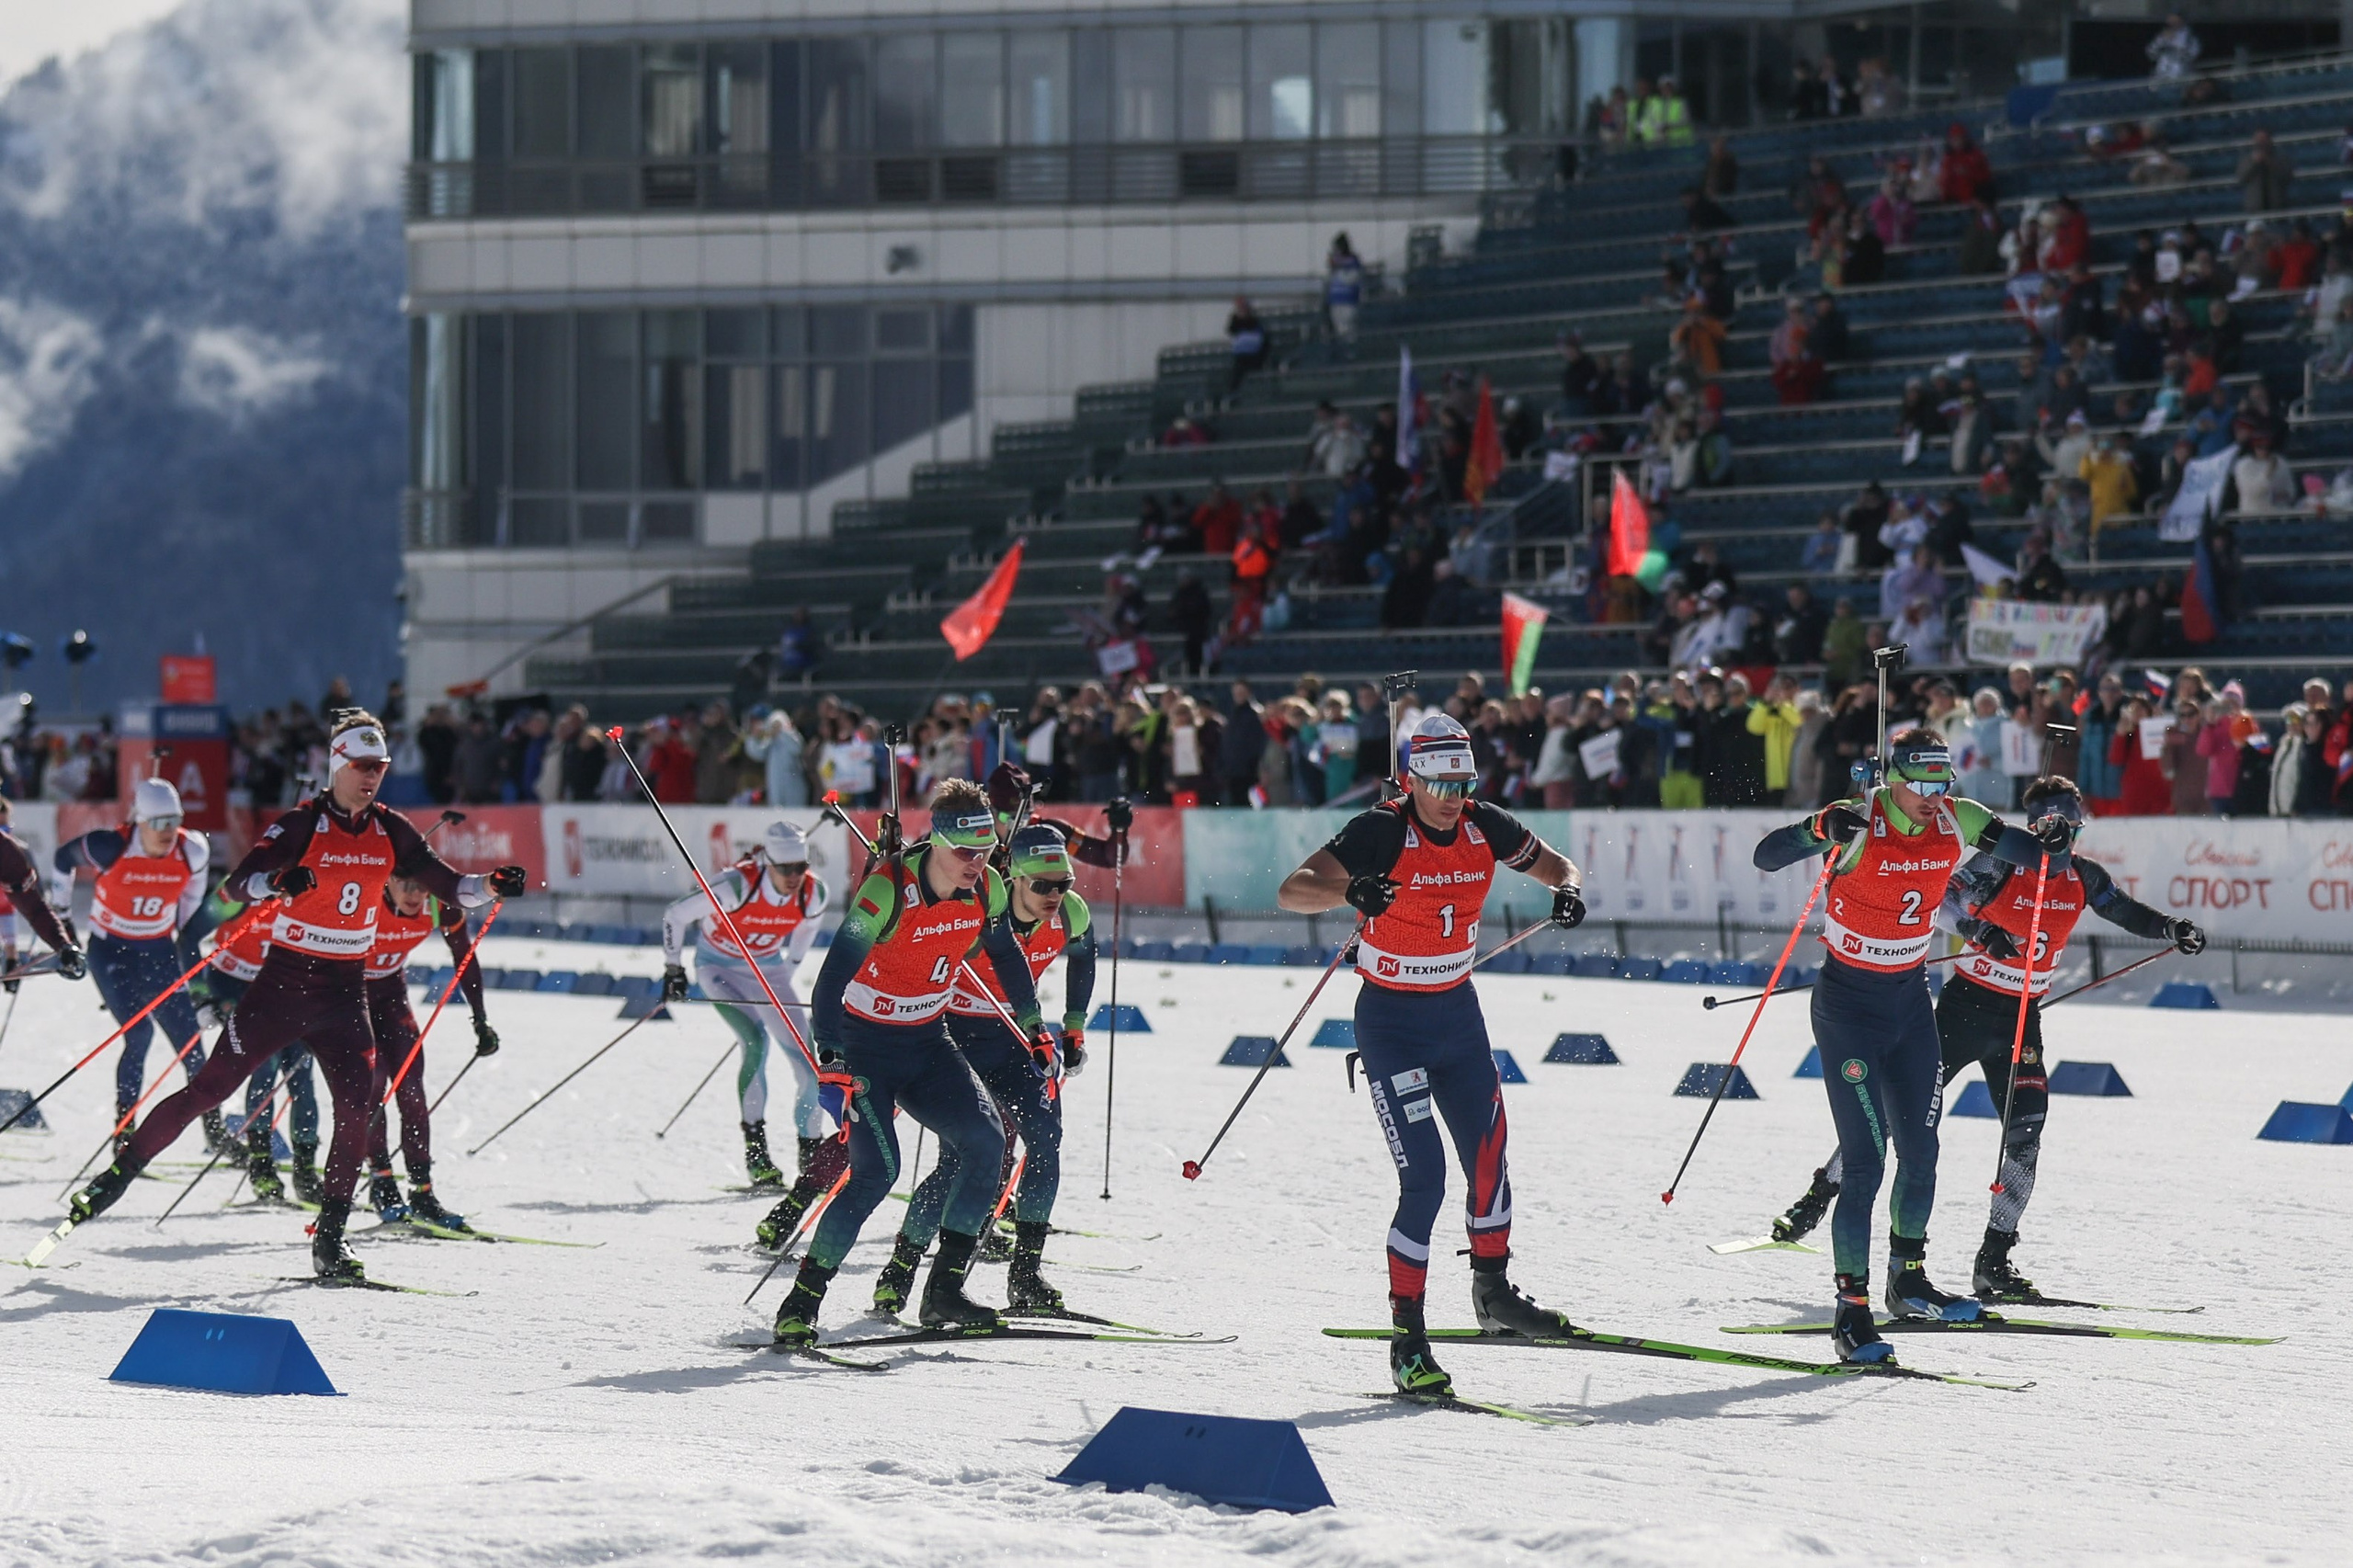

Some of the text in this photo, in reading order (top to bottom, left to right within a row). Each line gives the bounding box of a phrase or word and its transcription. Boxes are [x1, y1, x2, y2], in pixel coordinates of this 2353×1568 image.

[319, 852, 387, 867] Альфа Банк
[1878, 858, 1950, 876] Альфа Банк
[1410, 870, 1486, 890] Альфа Банк
[336, 881, 362, 915] 8
[2169, 875, 2271, 909] СПОРТ
[131, 895, 164, 918] 18
[1835, 898, 1844, 916] 2
[1897, 890, 1923, 926] 2
[2013, 895, 2076, 911] Альа Банк
[912, 917, 982, 942] Альфа Банк
[1439, 904, 1455, 937] 1
[1030, 948, 1059, 962] Банк
[2025, 929, 2049, 962] 6
[376, 953, 403, 967] 11
[868, 961, 880, 978] 4
[929, 955, 950, 984] 4
[2146, 1332, 2242, 1342] FISCHER
